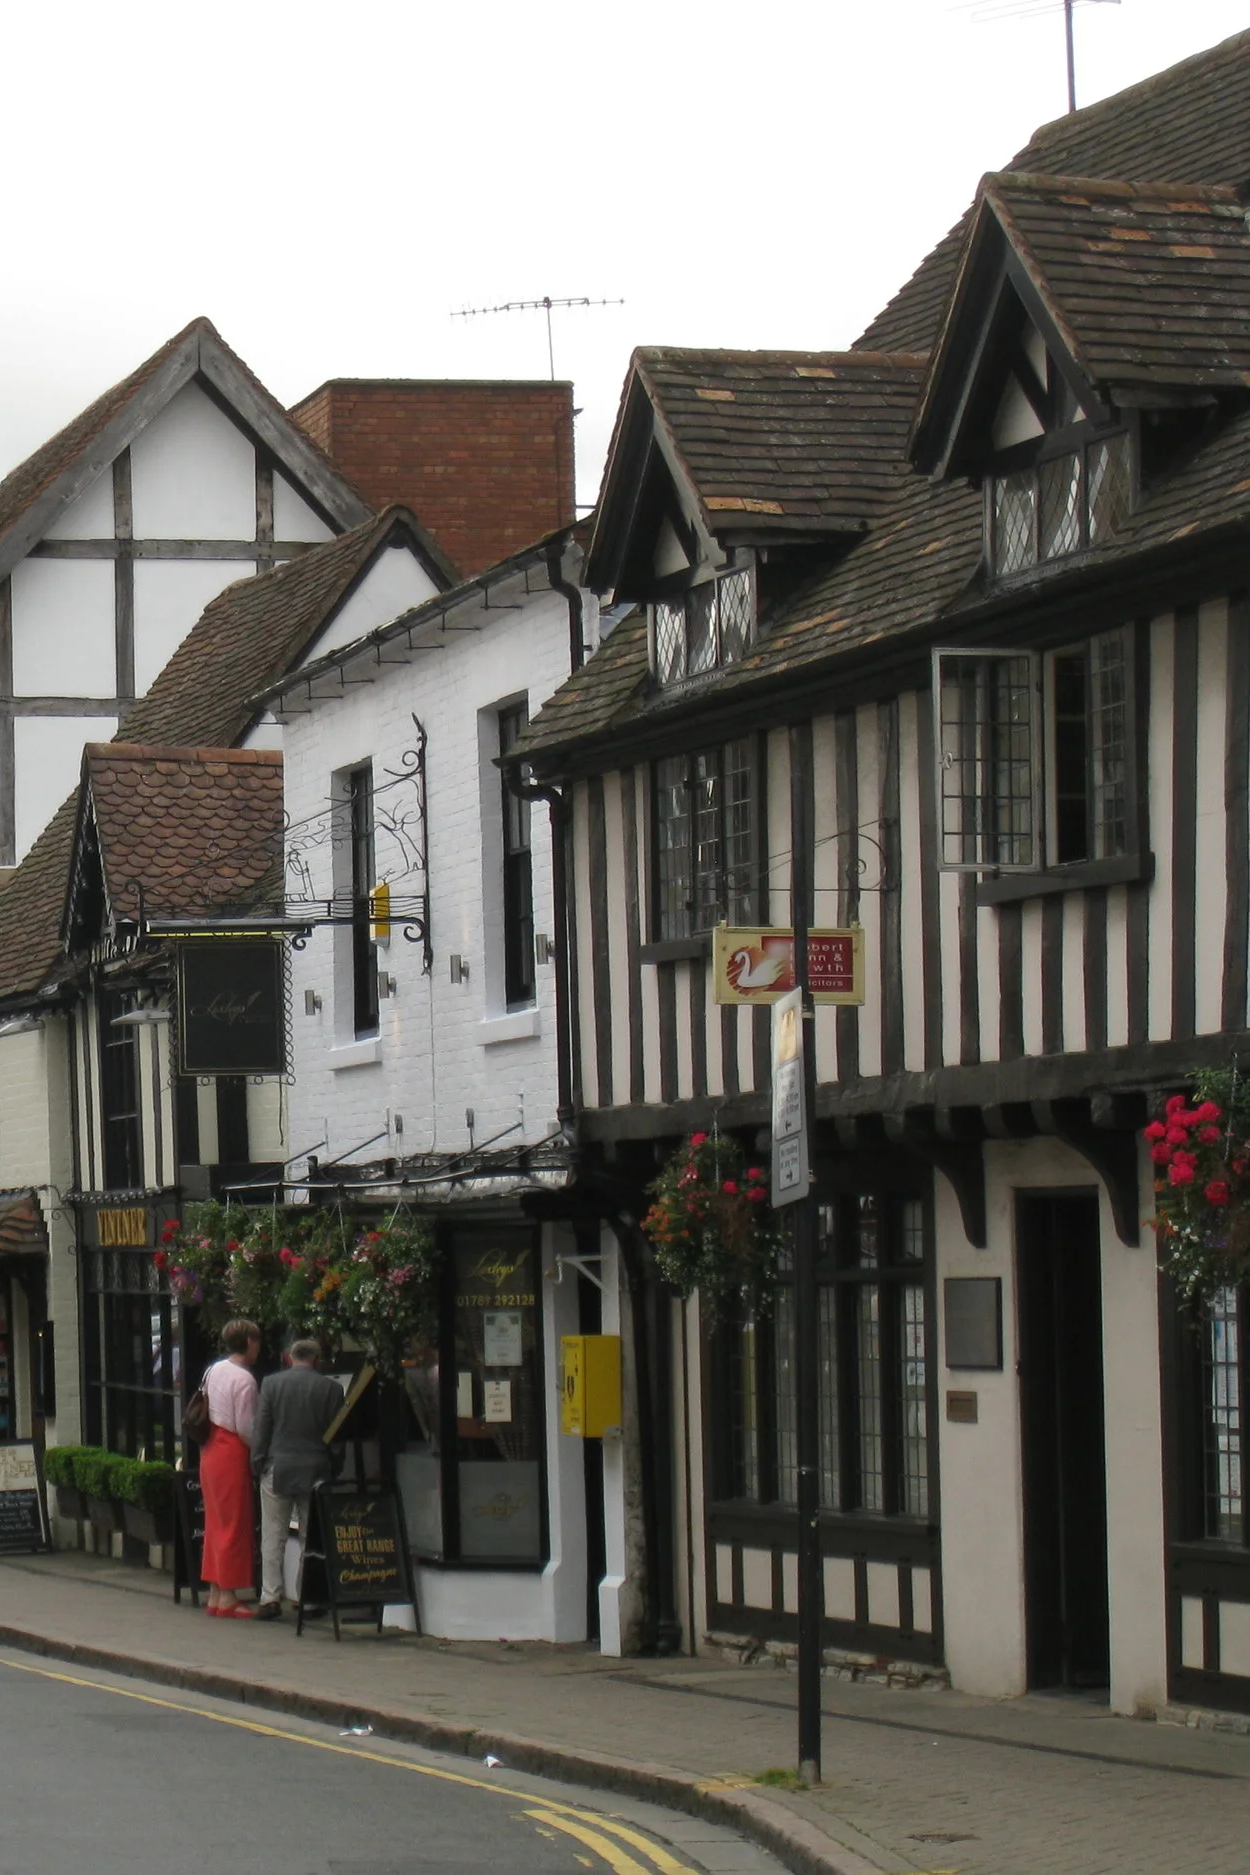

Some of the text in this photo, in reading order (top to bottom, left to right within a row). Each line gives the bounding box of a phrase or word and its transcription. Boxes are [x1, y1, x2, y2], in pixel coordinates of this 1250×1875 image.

[790, 942, 843, 951] bert
[833, 953, 843, 962] &
[790, 979, 843, 987] Sicitors
[96, 1208, 146, 1247] VINTNER
[494, 1294, 535, 1306] 292128
[335, 1526, 362, 1539] ENJOY
[337, 1539, 395, 1553] GREAT RANGE
[351, 1554, 385, 1565] Wines
[339, 1567, 397, 1584] Champagne
